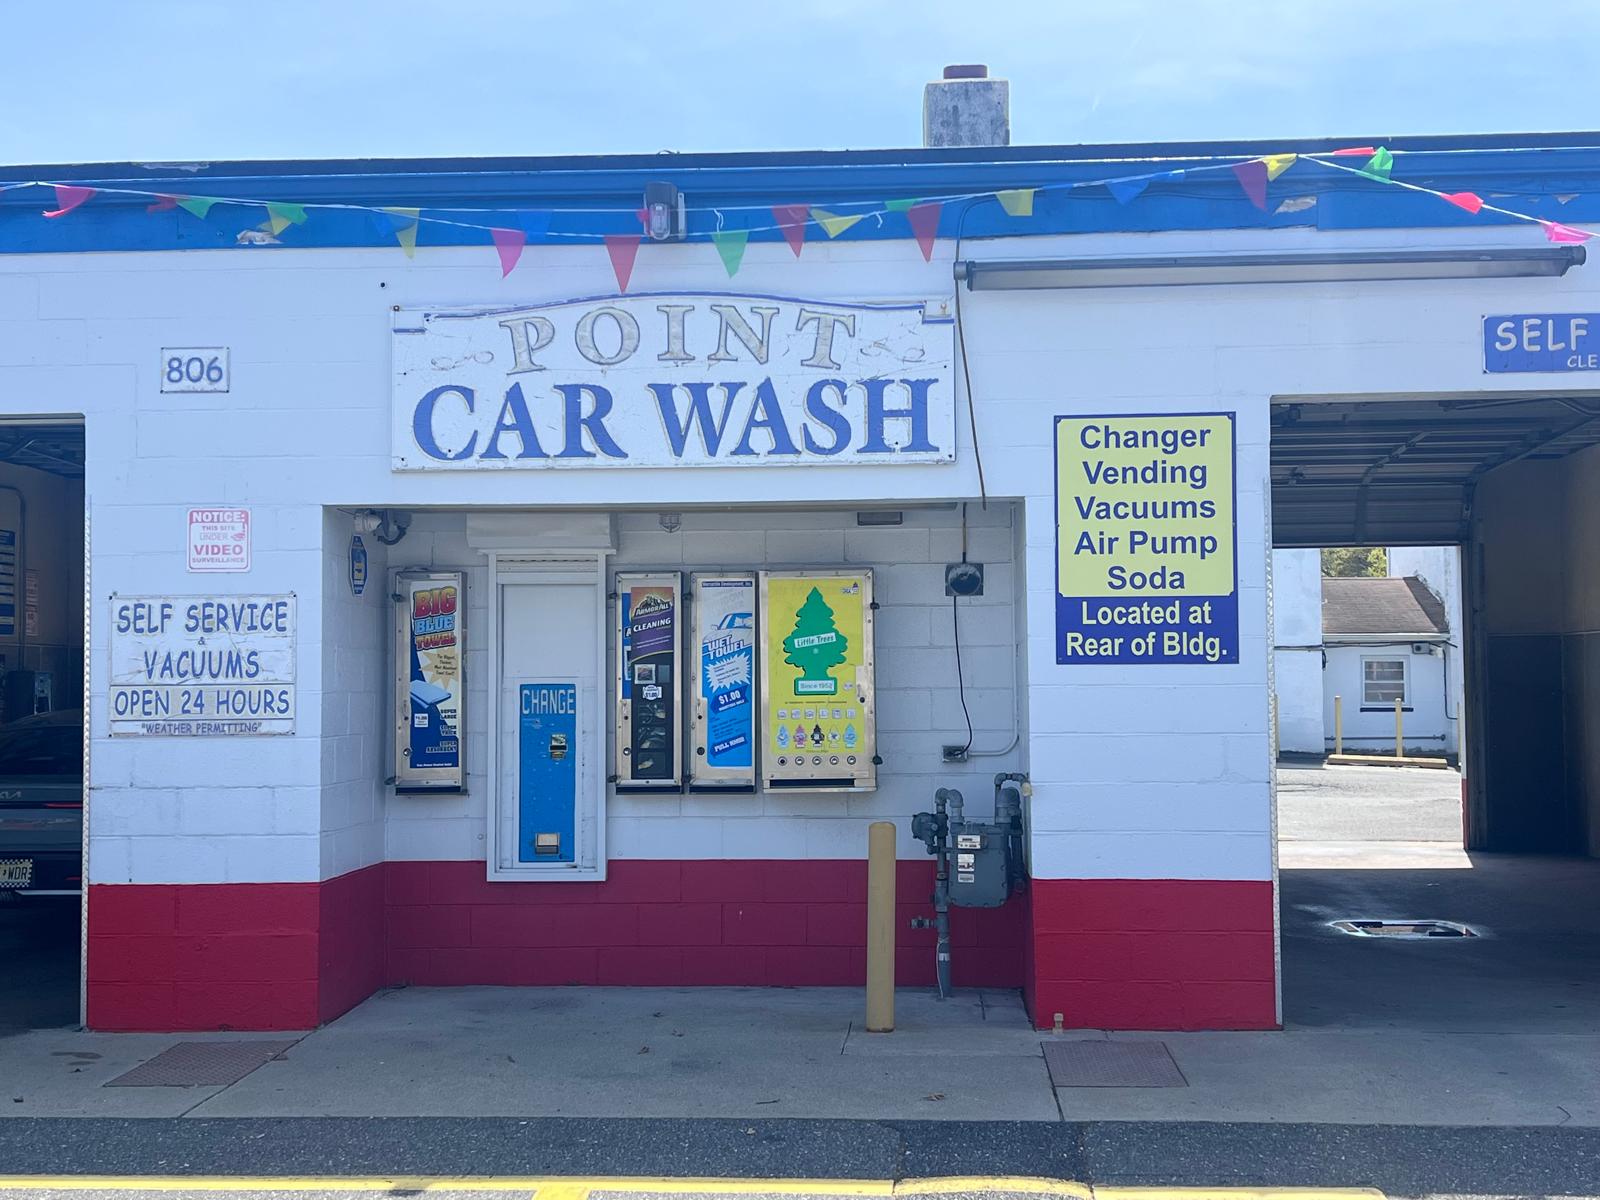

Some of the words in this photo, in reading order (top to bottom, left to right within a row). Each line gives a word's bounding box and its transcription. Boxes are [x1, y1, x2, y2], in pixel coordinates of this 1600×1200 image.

[499, 304, 855, 375] POINT
[1495, 318, 1588, 351] SELF
[167, 357, 223, 383] 806
[412, 382, 628, 461] CAR
[647, 377, 940, 459] WASH
[1080, 425, 1211, 454] Changer
[1082, 460, 1207, 489] Vending
[1074, 496, 1216, 519] Vacuums
[194, 544, 243, 555] VIDEO
[1074, 531, 1119, 555] Air
[1130, 530, 1217, 560] Pump
[1108, 565, 1185, 590] Soda
[414, 587, 457, 619] BIG
[1082, 600, 1180, 625] Located
[1188, 601, 1212, 625] at
[117, 603, 173, 634] SELF
[185, 601, 288, 633] SERVICE
[415, 615, 455, 634] BLUE
[633, 617, 671, 632] CLEANING
[197, 636, 206, 645] &
[708, 634, 732, 650] WET
[709, 640, 745, 660] TOWEL
[796, 637, 815, 647] Little
[817, 635, 834, 644] Trees
[1066, 632, 1123, 656] Rear
[1131, 631, 1156, 656] of
[1163, 631, 1227, 661] Bldg.
[144, 649, 260, 679] VACUUMS
[114, 689, 170, 716] OPEN
[181, 690, 205, 715] 24
[216, 689, 290, 715] HOURS
[522, 689, 575, 714] CHANGE
[718, 690, 741, 705] $1.00
[141, 723, 193, 734] "WEATHER
[196, 722, 262, 734] PERMITTING"
